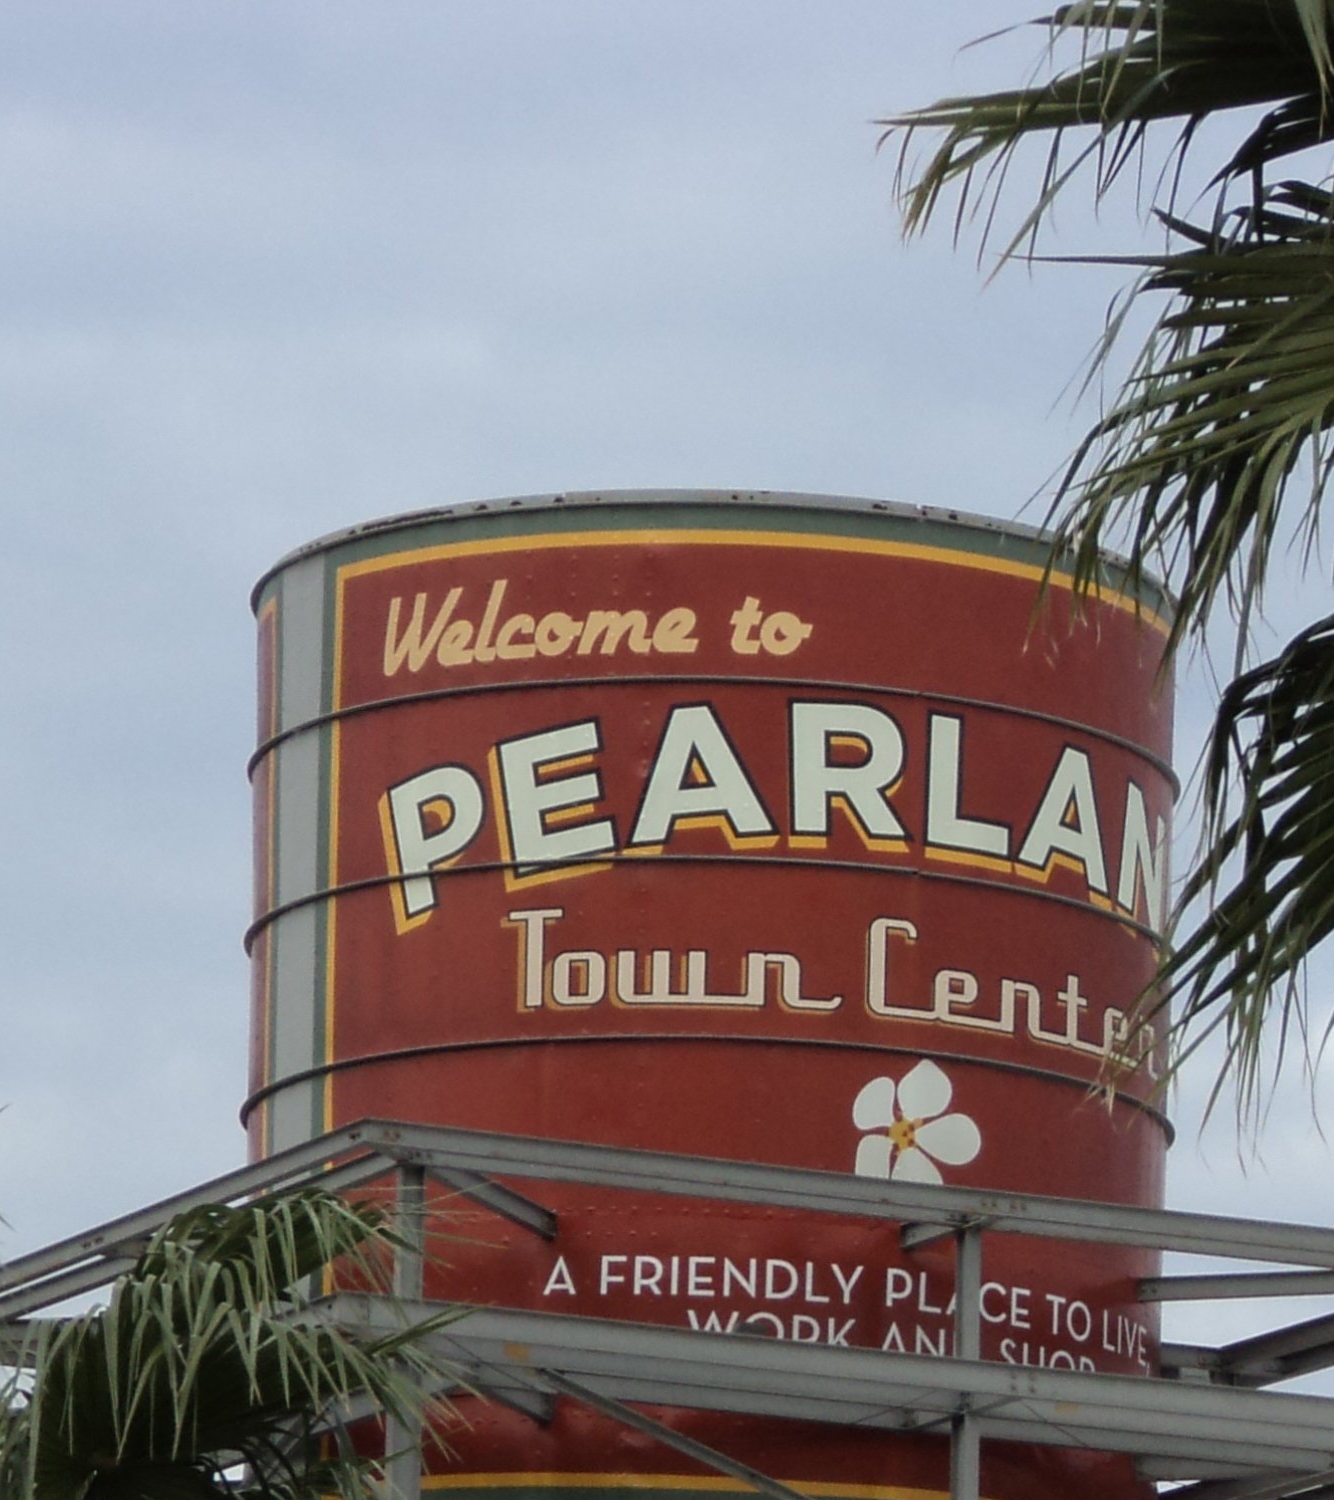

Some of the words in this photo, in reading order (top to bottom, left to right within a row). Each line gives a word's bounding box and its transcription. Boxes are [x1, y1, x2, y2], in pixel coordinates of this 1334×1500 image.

[382, 578, 700, 677] Welcome
[730, 596, 814, 656] to
[503, 907, 843, 1013] Town
[542, 1254, 577, 1296] A
[599, 1254, 865, 1305] FRIENDLY
[884, 1267, 1032, 1330] PLCE
[1045, 1293, 1093, 1342] TO
[686, 1309, 857, 1347] WORK
[880, 1321, 959, 1358] AN
